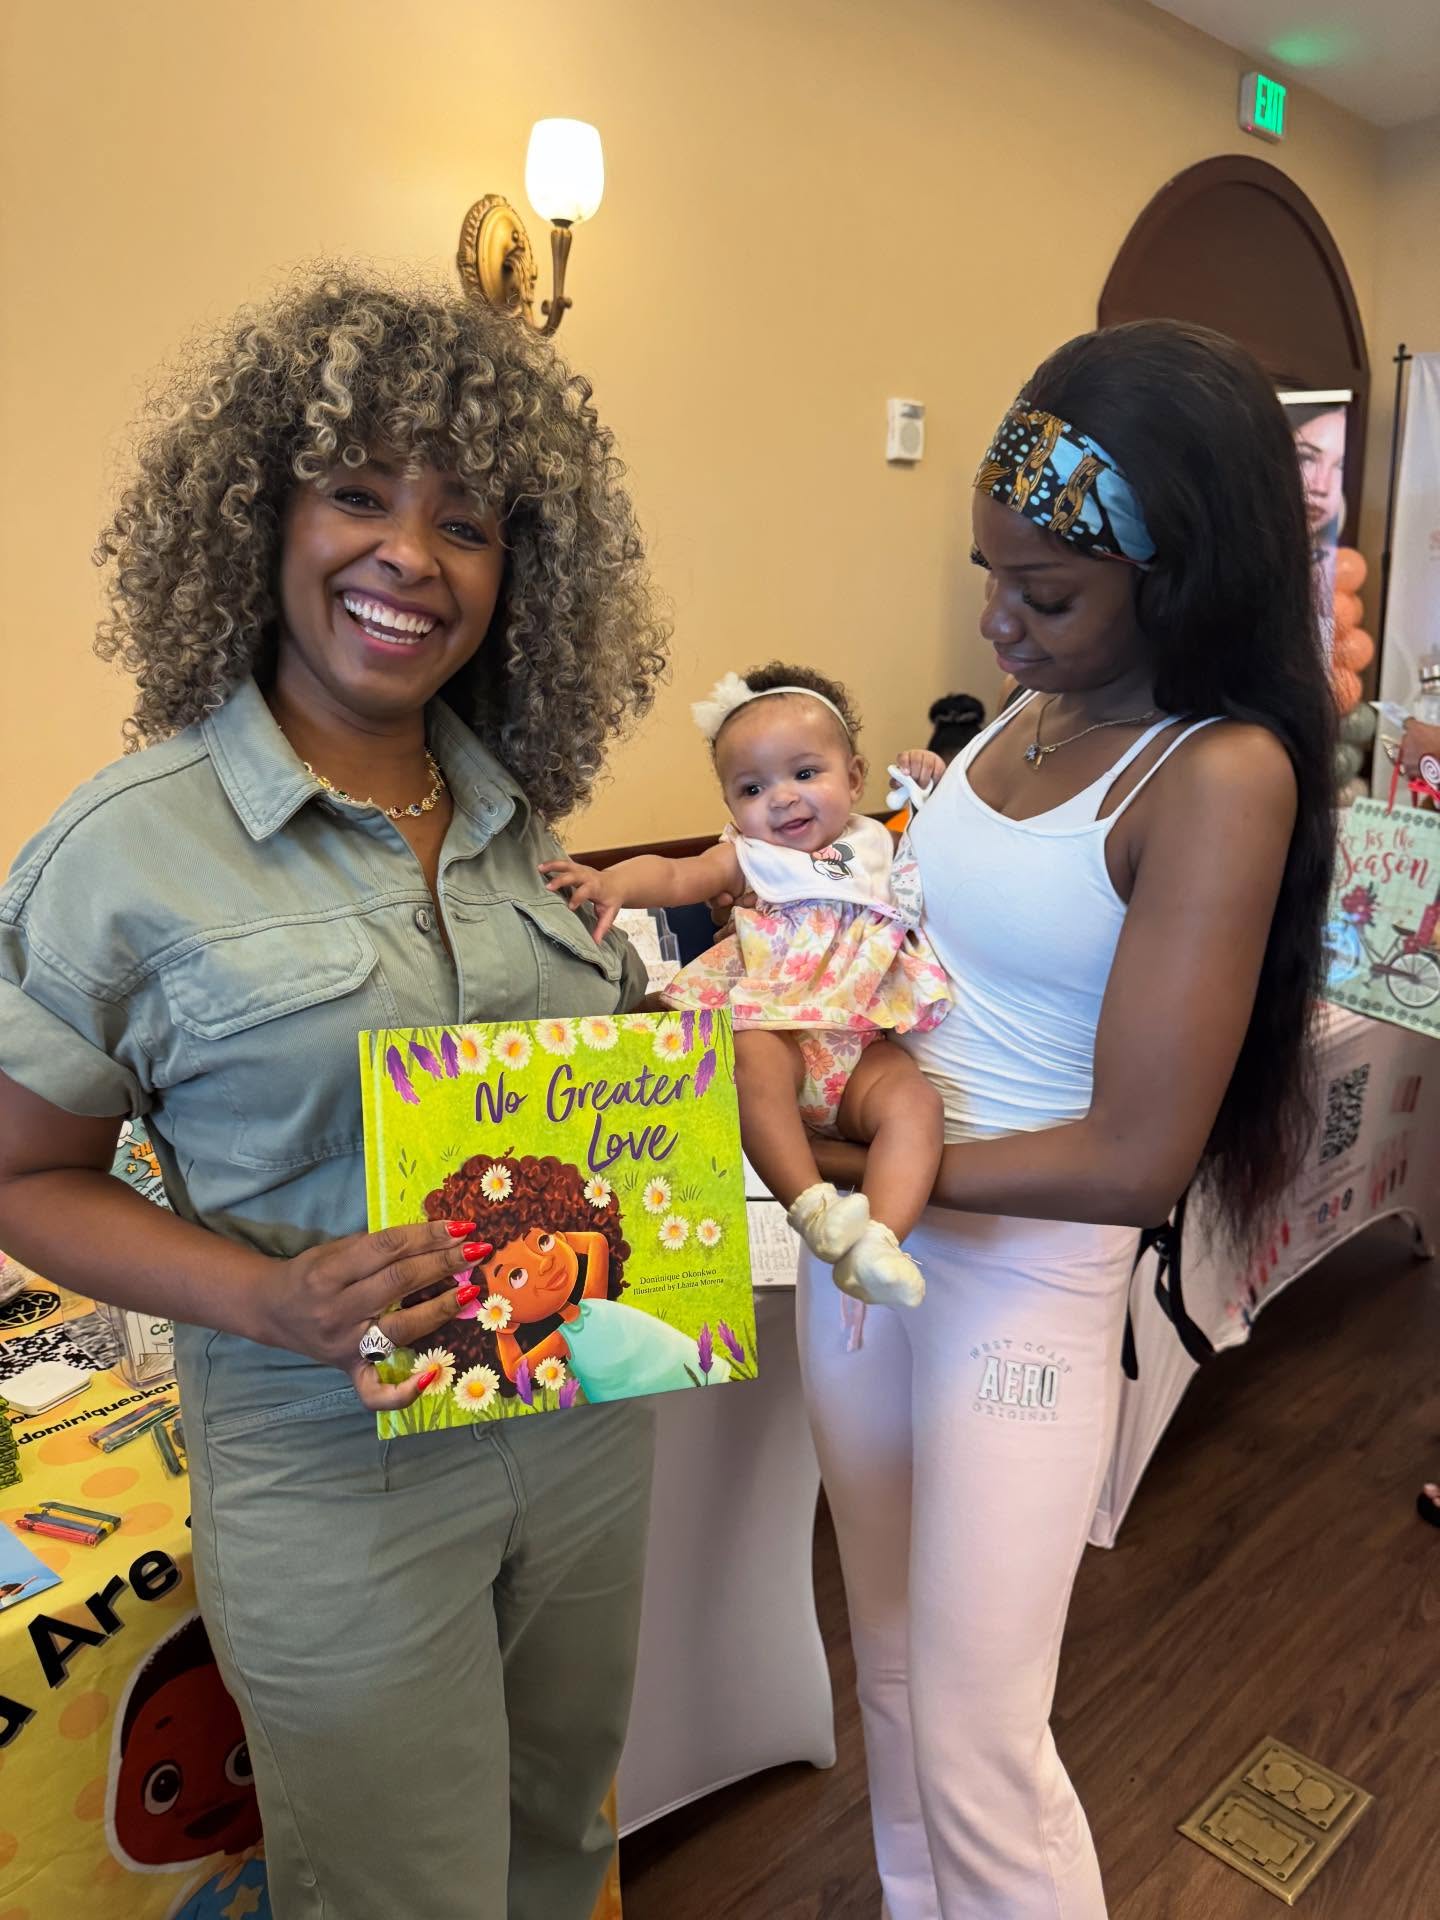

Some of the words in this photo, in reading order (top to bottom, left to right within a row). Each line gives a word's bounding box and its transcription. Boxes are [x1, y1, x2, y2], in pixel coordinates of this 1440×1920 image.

[1254, 73, 1287, 135] EXIT
[1336, 840, 1429, 889] Season
[475, 1071, 528, 1124] No
[546, 1063, 694, 1123] Greater
[587, 1113, 680, 1173] Love
[633, 1284, 666, 1296] Illustrated
[667, 1282, 676, 1292] by
[639, 1273, 680, 1285] Dominique
[681, 1268, 717, 1280] Okonkwo
[977, 1355, 1061, 1409] AERO
[1024, 1342, 1073, 1375] COAST
[27, 1549, 182, 1689] Are
